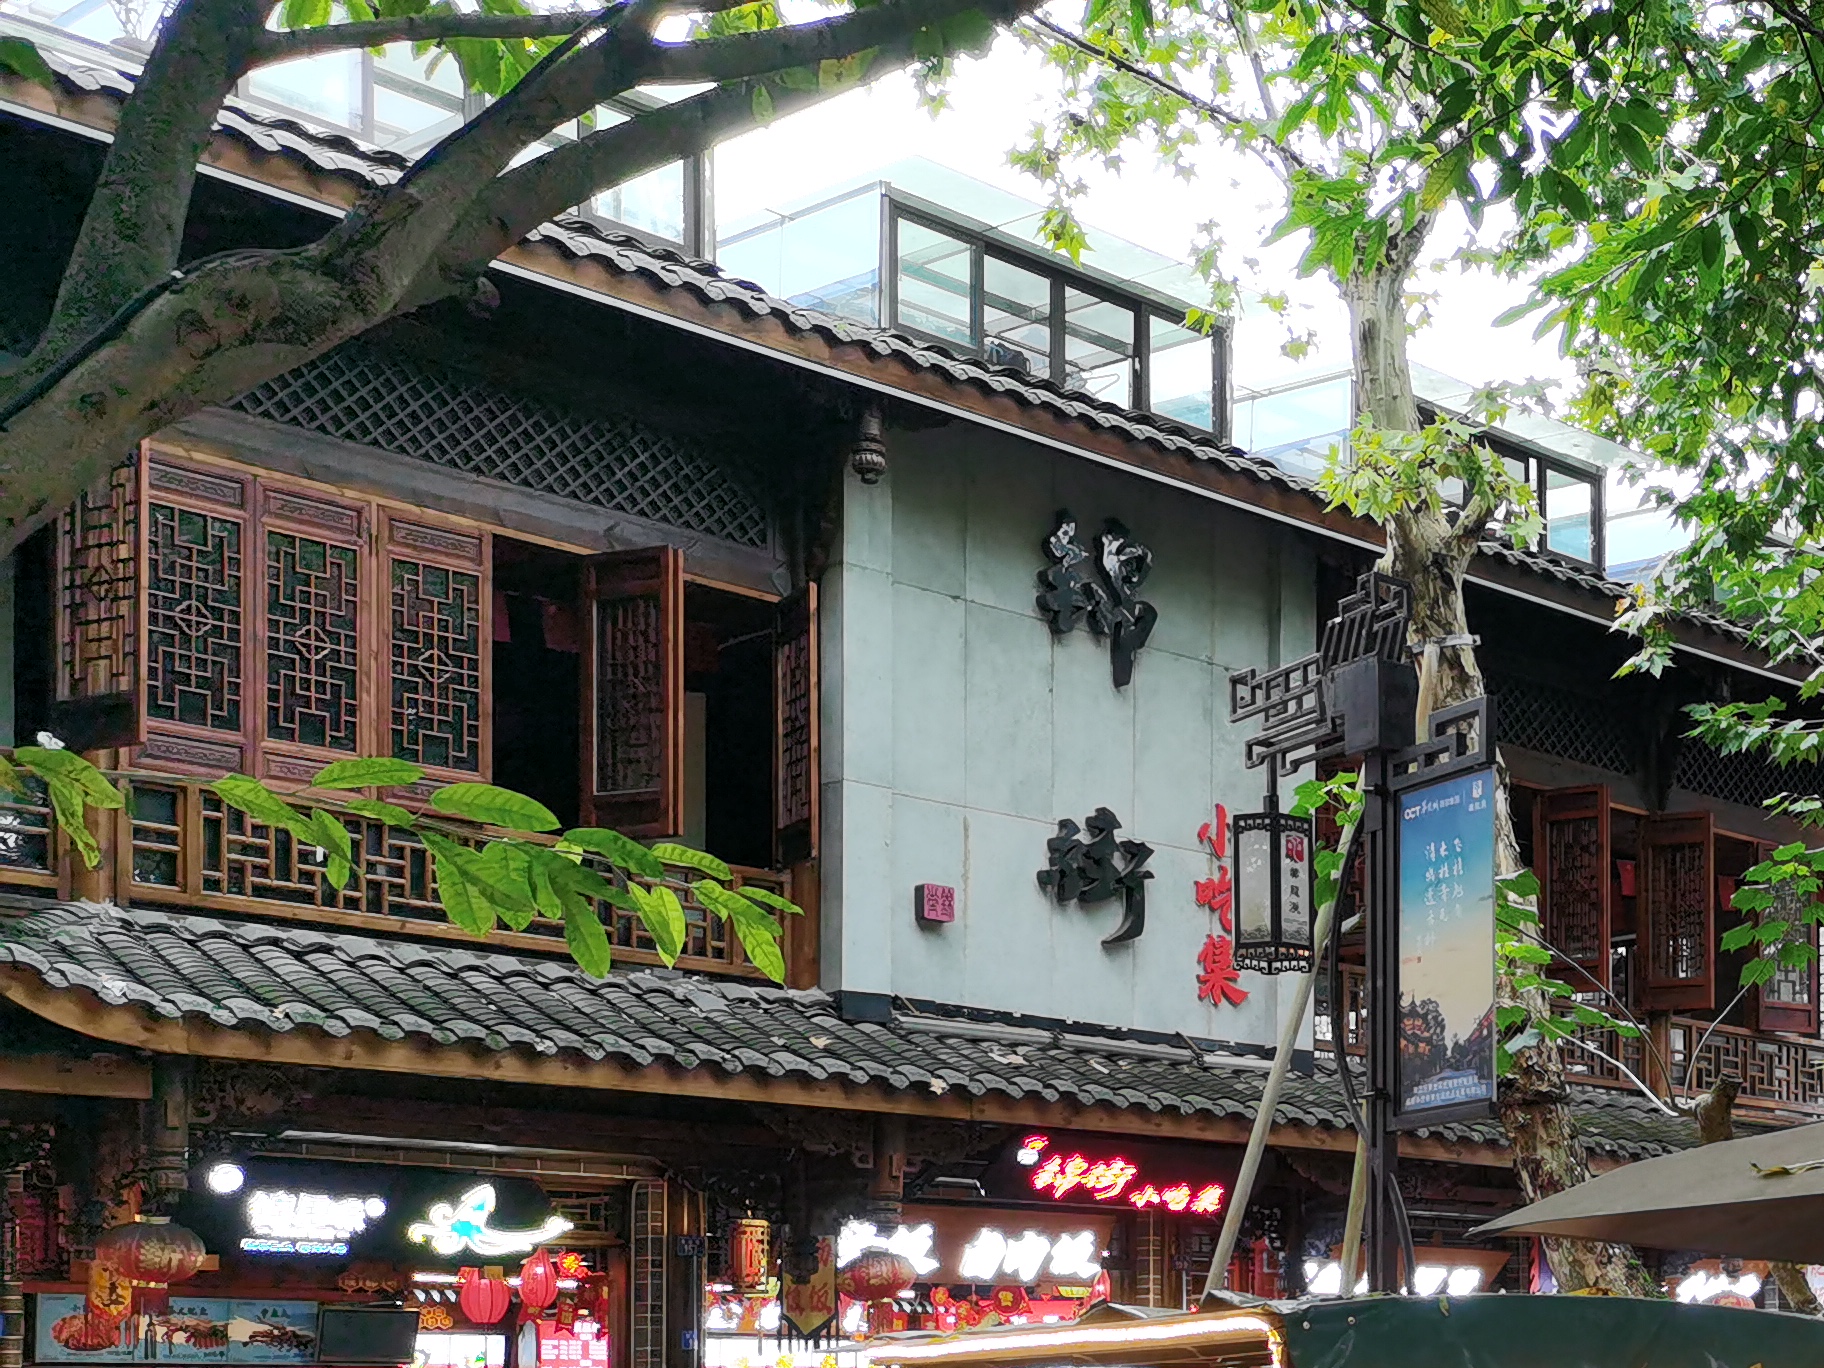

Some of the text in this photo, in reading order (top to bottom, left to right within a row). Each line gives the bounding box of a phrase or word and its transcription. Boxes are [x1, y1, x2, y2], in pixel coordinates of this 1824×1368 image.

[1404, 806, 1421, 820] OCT
[1194, 803, 1250, 1006] 小吃集
